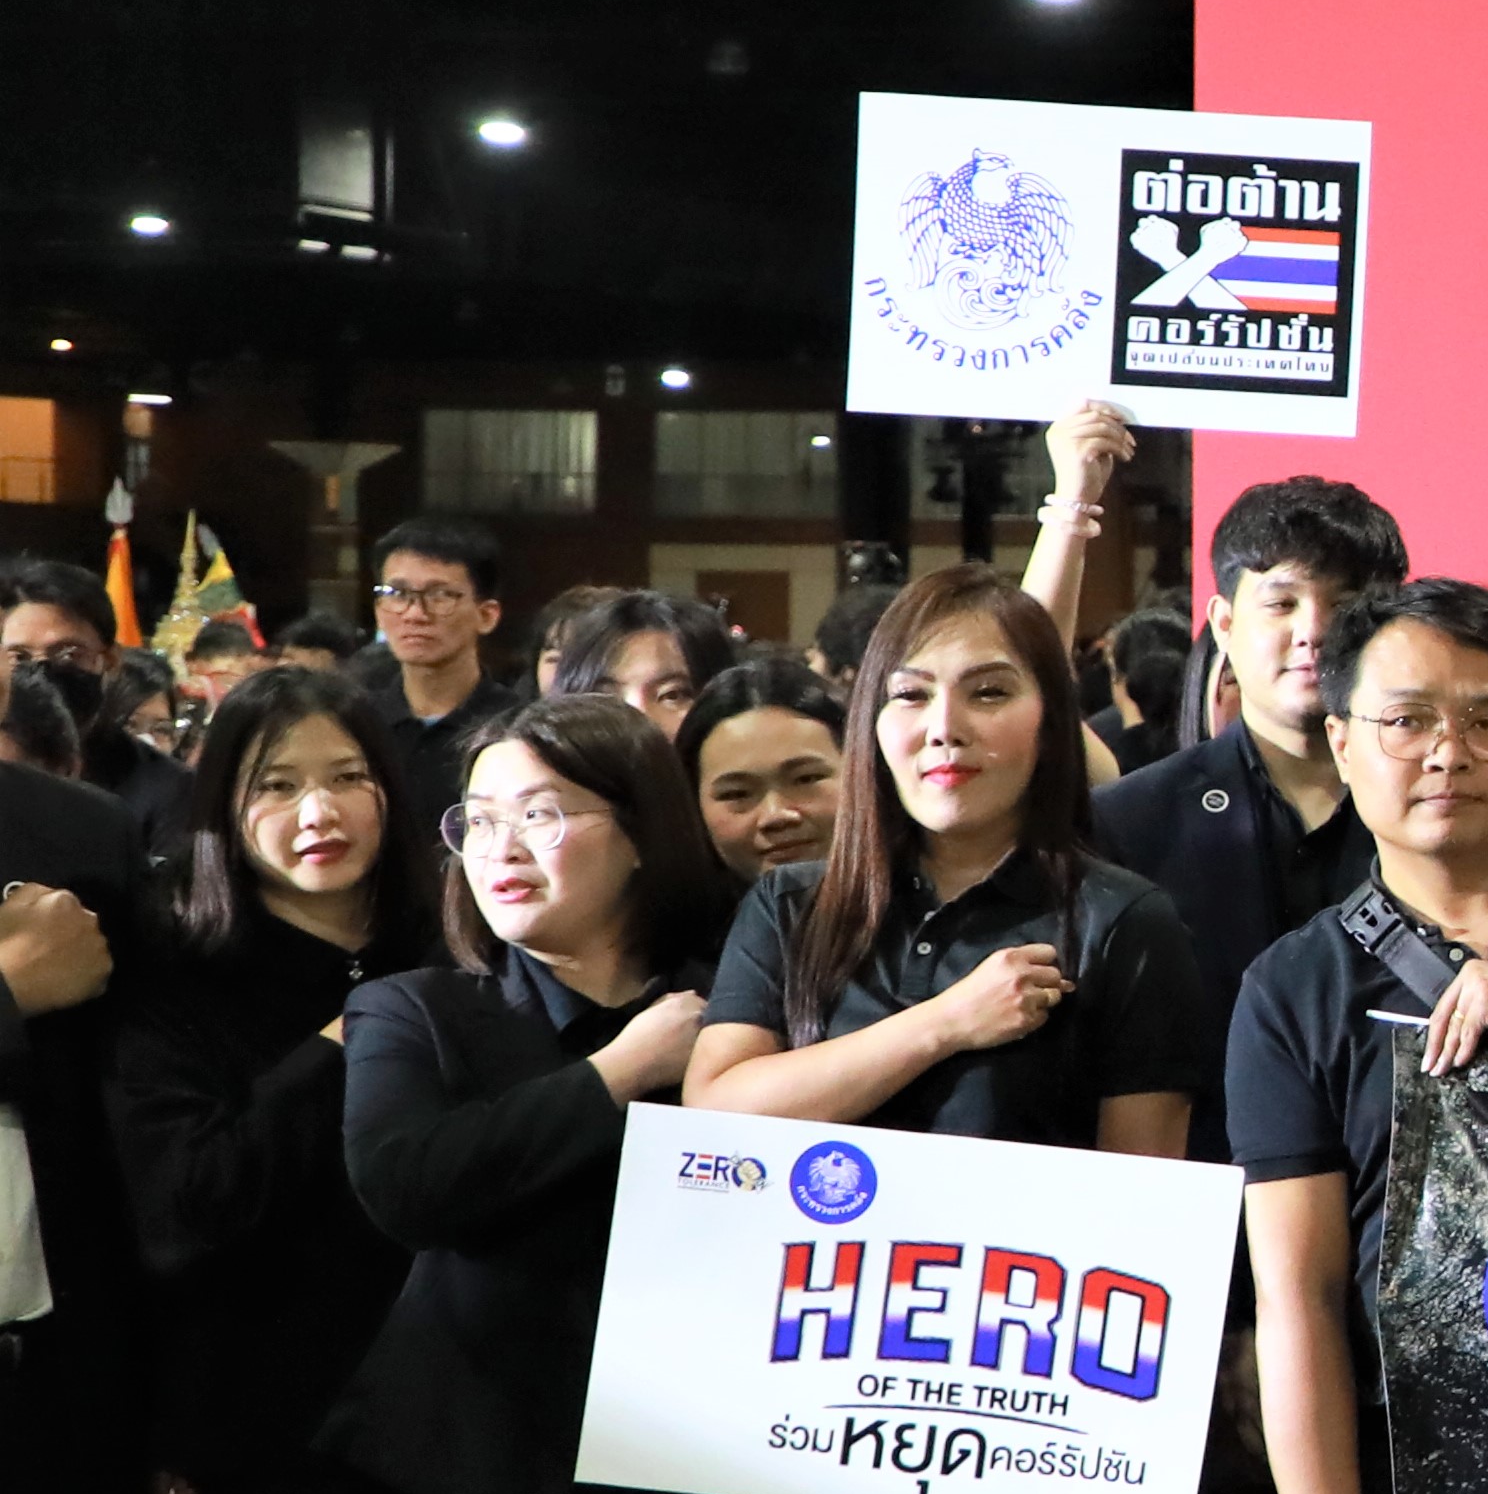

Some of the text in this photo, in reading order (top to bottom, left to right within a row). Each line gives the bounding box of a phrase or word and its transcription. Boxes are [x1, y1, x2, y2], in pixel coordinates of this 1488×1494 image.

[1132, 159, 1340, 222] ต่อต้าน
[862, 273, 1104, 371] กระทรวงการคลัง
[1126, 313, 1334, 352] คอร์รัปชั่น
[770, 1240, 1170, 1402] HERO
[857, 1374, 1070, 1417] OF THE TRUTH
